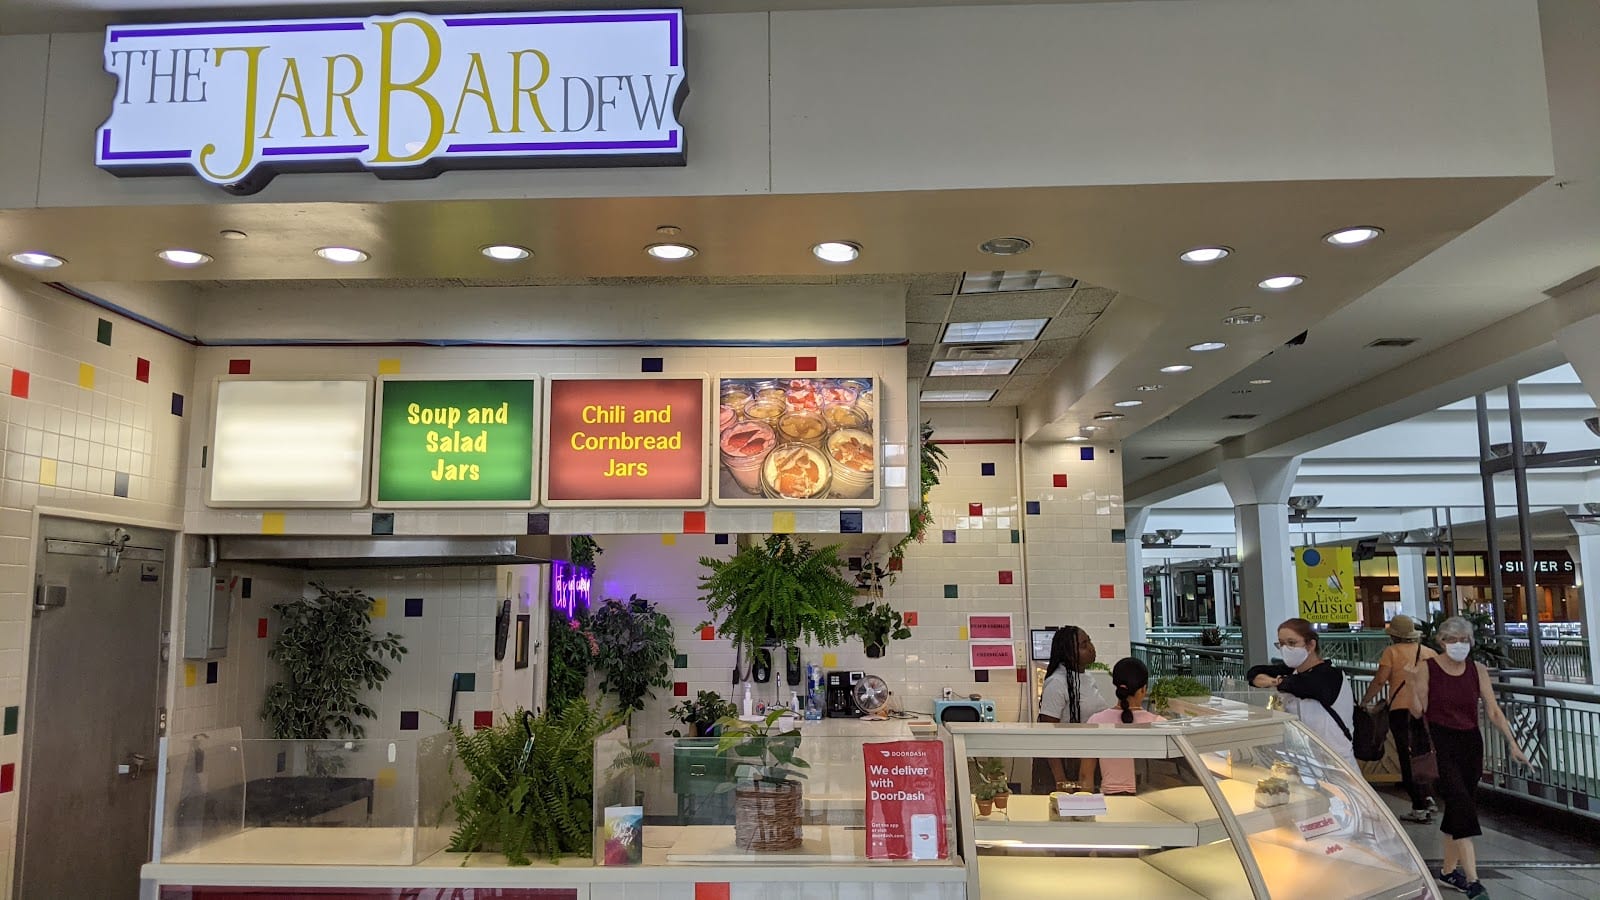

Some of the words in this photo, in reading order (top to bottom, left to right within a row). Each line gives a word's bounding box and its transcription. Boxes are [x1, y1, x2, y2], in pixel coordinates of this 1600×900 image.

[112, 48, 209, 104] THE
[200, 46, 367, 179] JAR
[369, 18, 556, 163] BAR
[560, 73, 677, 133] DFW
[407, 403, 461, 428] Soup
[467, 402, 508, 424] and
[582, 405, 626, 424] Chili
[633, 405, 671, 424] and
[426, 430, 487, 453] Salad
[570, 431, 682, 451] Cornbread
[431, 458, 480, 481] Jars
[604, 458, 648, 478] Jars
[1505, 561, 1558, 572] SIER
[1317, 593, 1340, 603] Live
[1303, 600, 1353, 614] Music
[891, 750, 927, 758] DOORDASH
[870, 765, 889, 776] We
[891, 765, 929, 776] deliver
[870, 778, 894, 788] with
[871, 790, 925, 801] DoorDash
